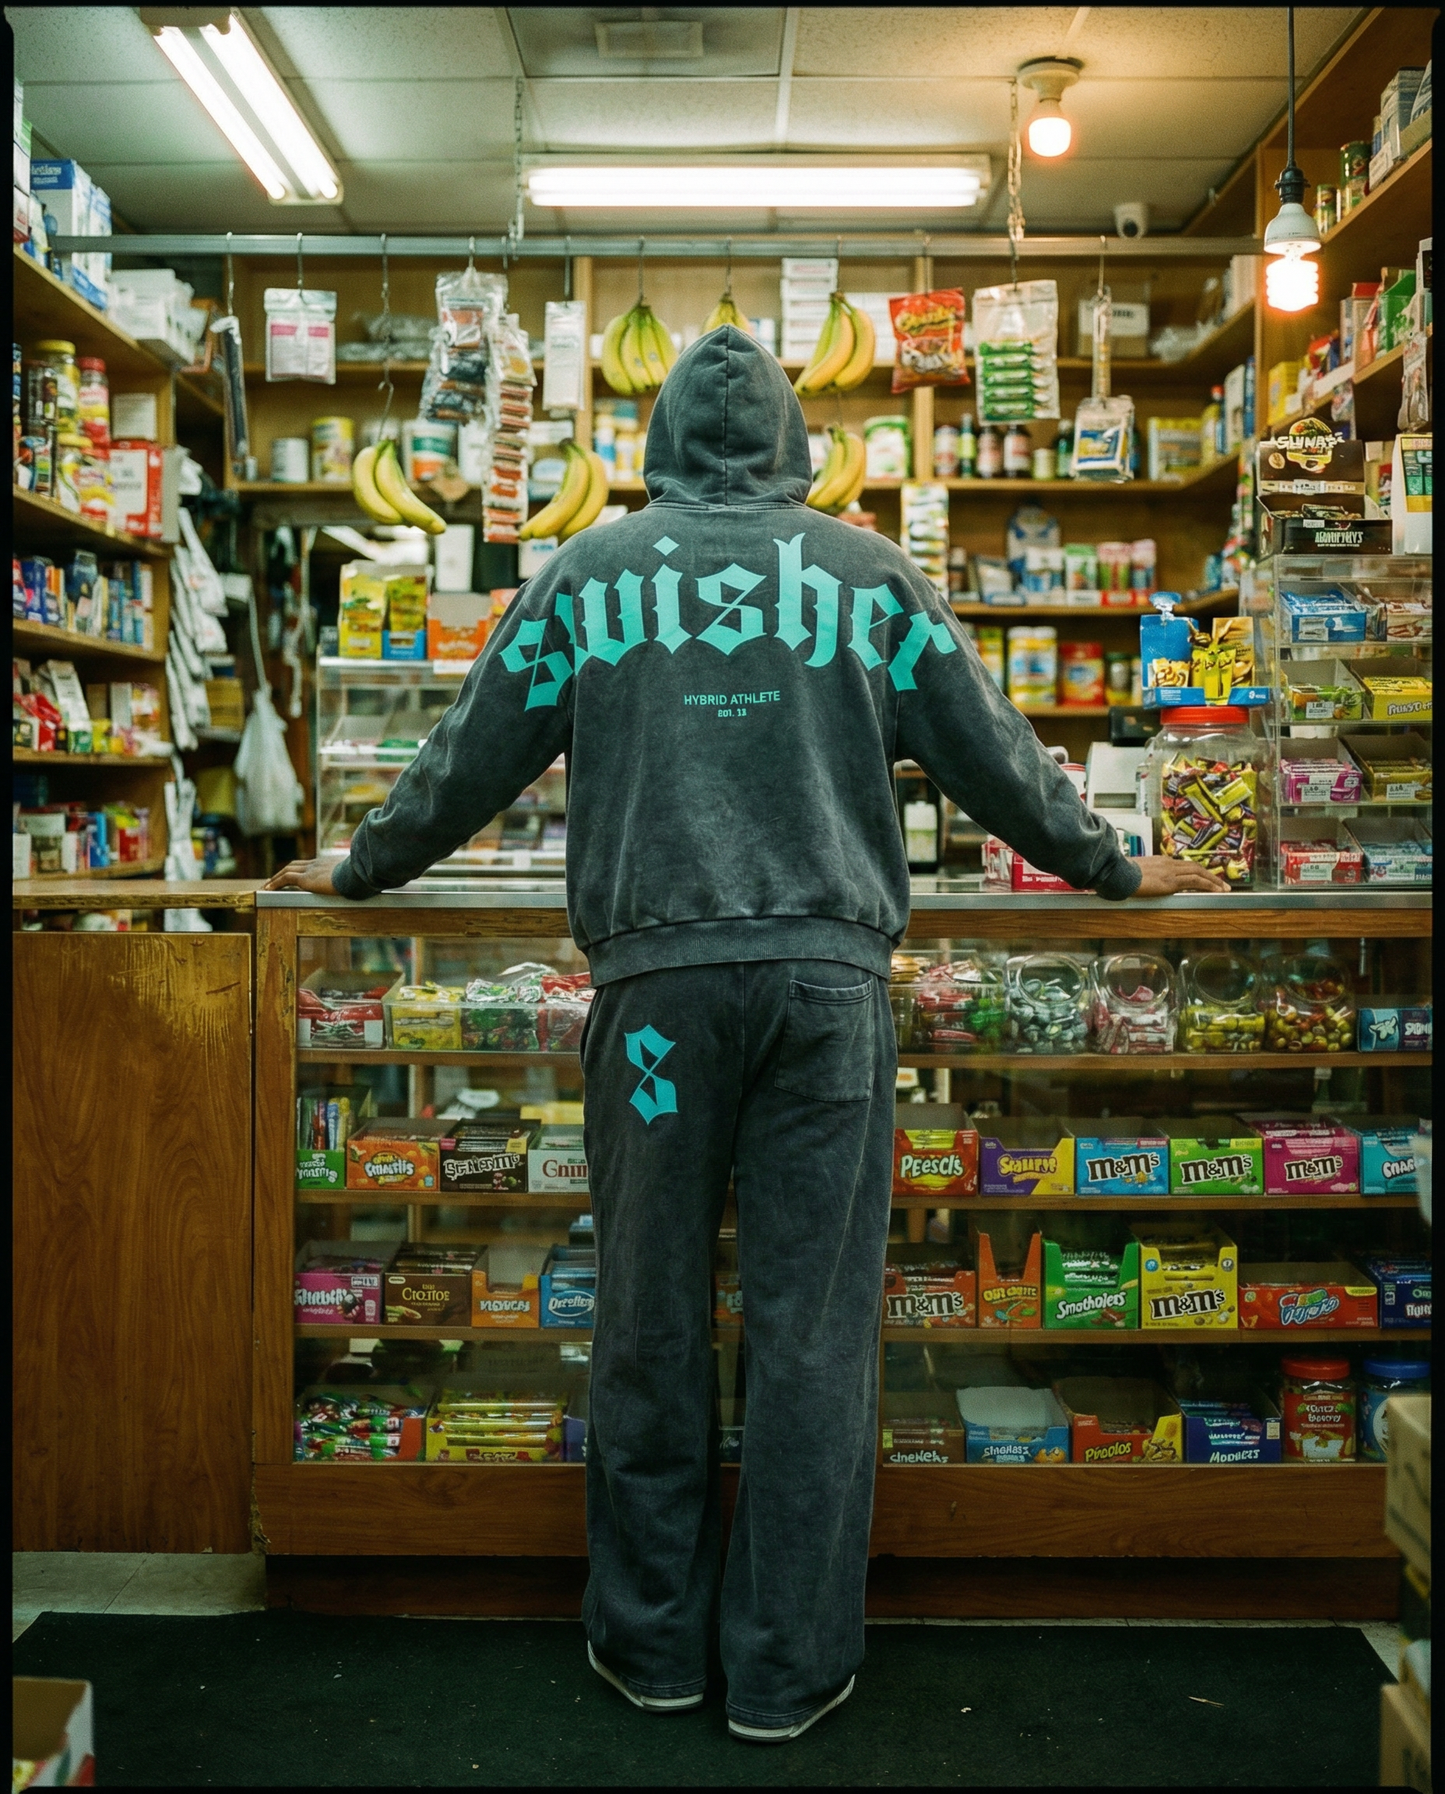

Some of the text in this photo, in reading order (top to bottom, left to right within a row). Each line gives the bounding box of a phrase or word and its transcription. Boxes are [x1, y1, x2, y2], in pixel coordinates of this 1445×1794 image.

[499, 532, 957, 712] swisher
[684, 690, 782, 706] HYBRID ATHLETE
